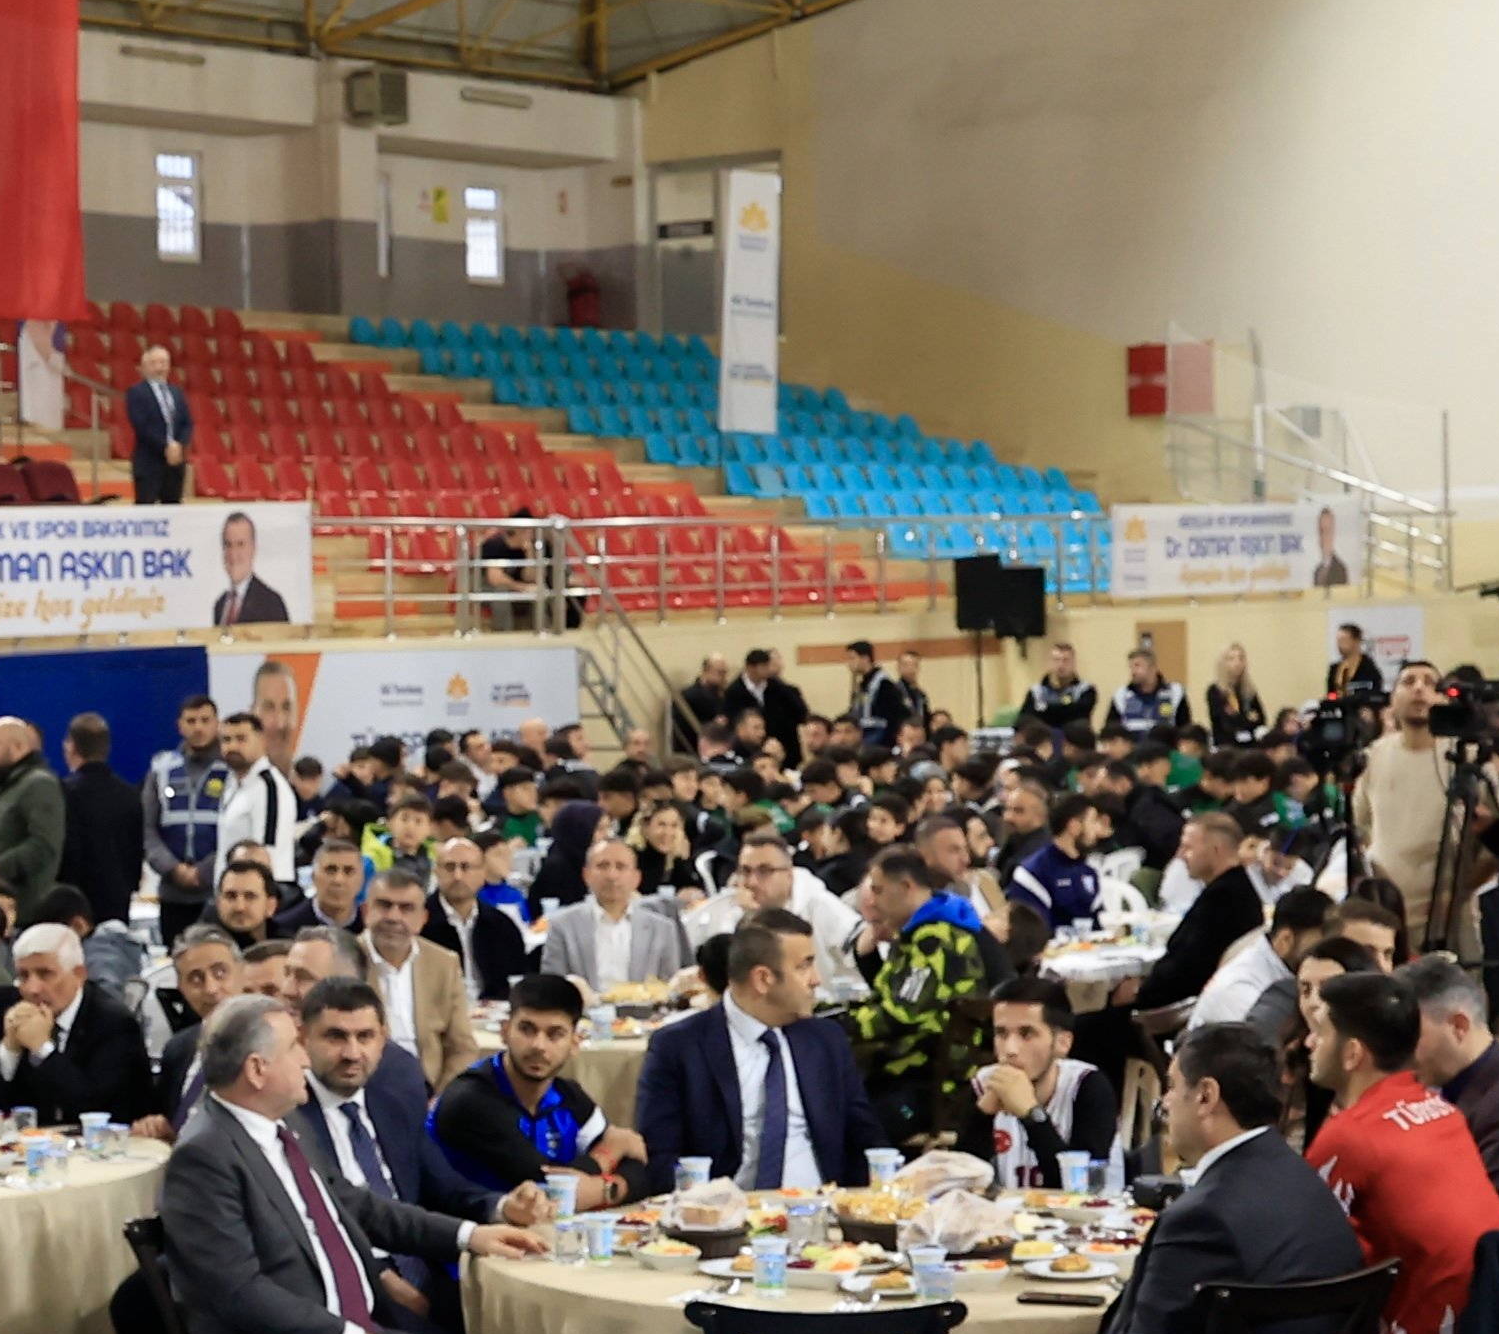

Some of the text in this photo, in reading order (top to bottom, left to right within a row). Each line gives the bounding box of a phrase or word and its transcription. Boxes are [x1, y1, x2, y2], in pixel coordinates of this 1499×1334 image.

[11, 520, 31, 540] VE
[35, 520, 78, 540] SPOR
[82, 518, 170, 539] BAKANIMIZ
[59, 549, 135, 590] AŞKIN
[143, 548, 193, 578] BAK
